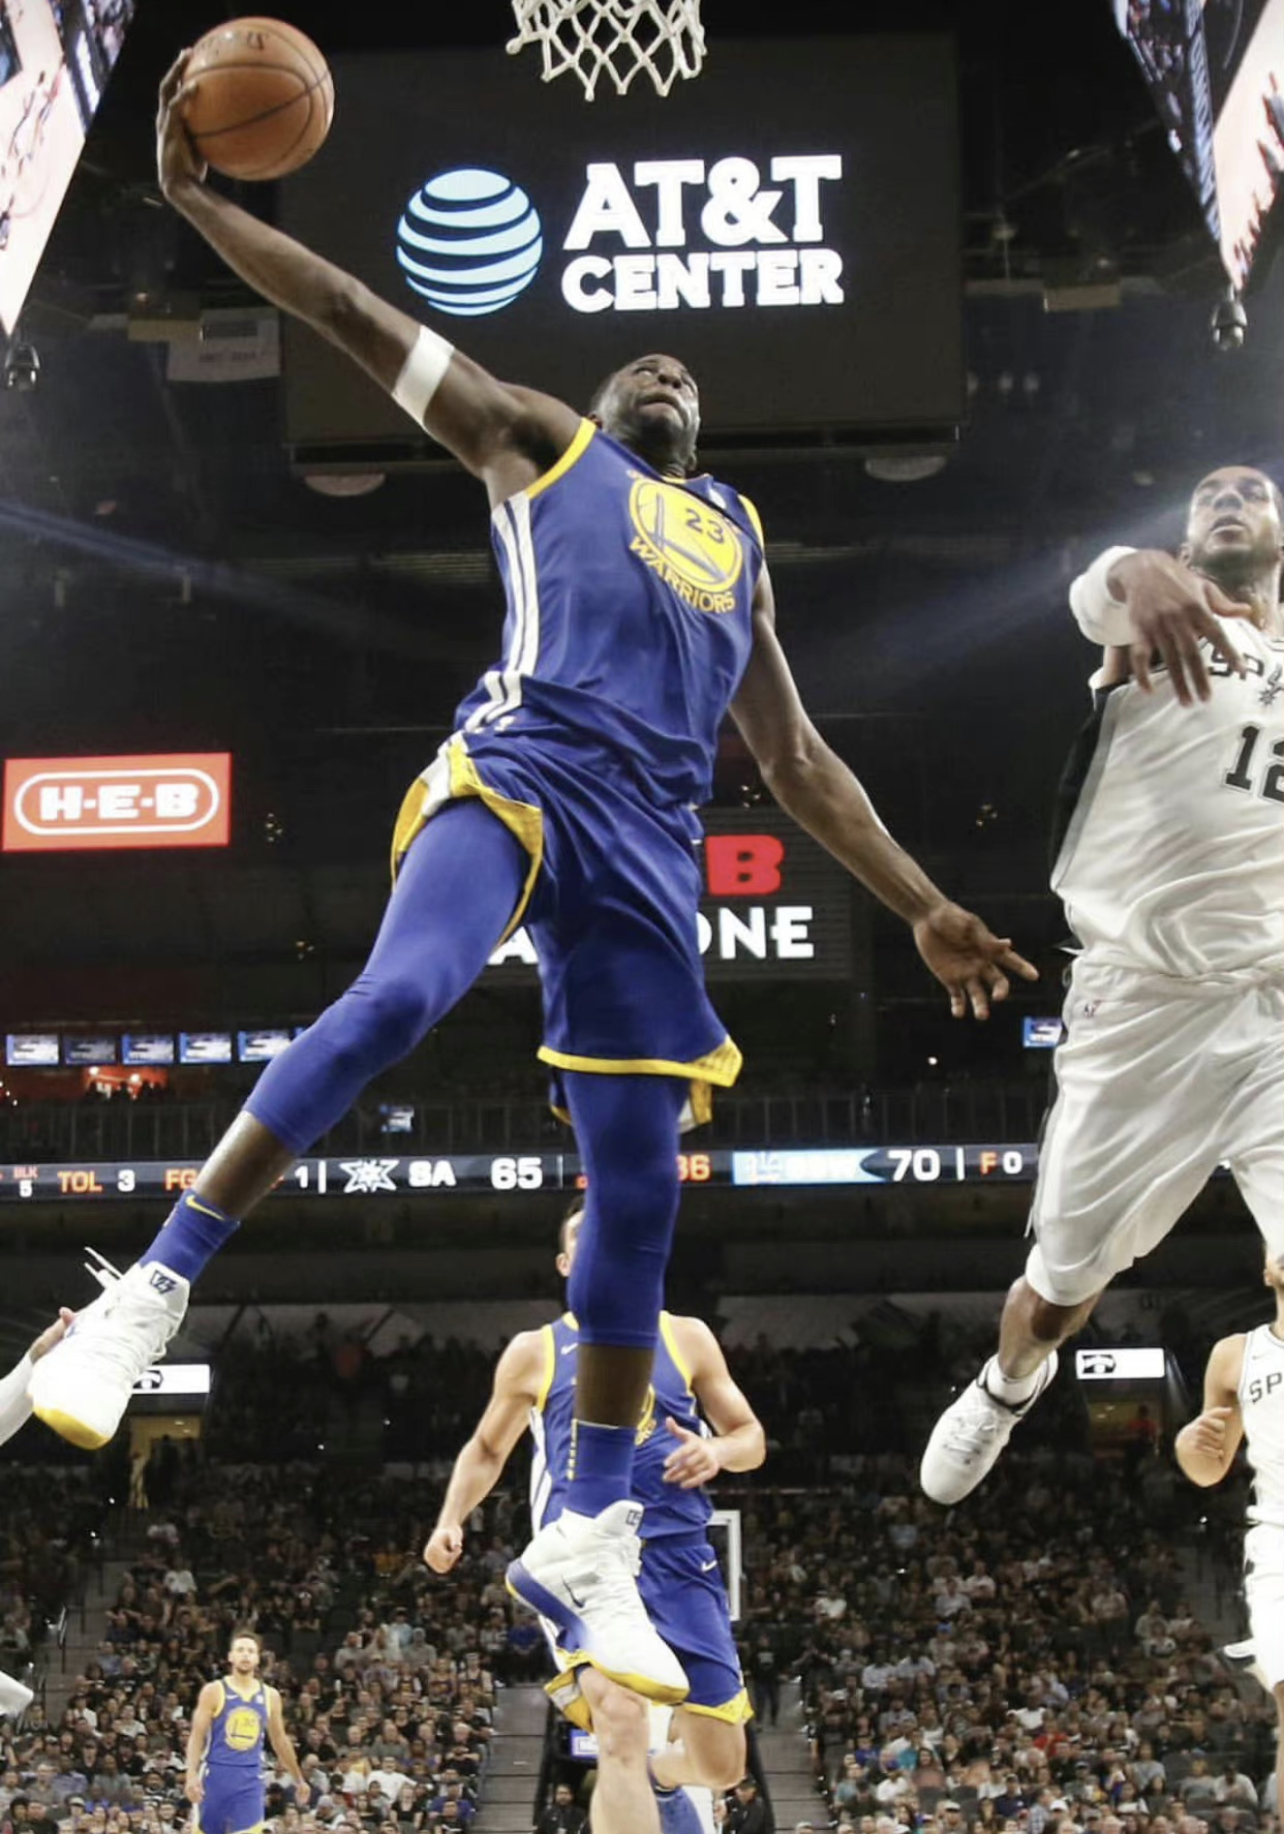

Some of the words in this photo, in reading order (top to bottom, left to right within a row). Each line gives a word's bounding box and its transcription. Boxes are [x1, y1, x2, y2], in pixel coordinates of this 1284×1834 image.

[562, 154, 842, 250] AT&T
[561, 248, 844, 313] CENTER
[685, 507, 724, 545] 23
[628, 535, 736, 614] WARRIORS
[39, 783, 199, 822] H-E-B
[408, 1160, 457, 1187] SA
[491, 1157, 543, 1189] 65
[887, 1149, 941, 1182] 70
[980, 1151, 998, 1175] F
[1002, 1151, 1023, 1175] 0
[19, 1180, 33, 1198] 5
[57, 1170, 103, 1193] TOL
[117, 1169, 136, 1192] 3
